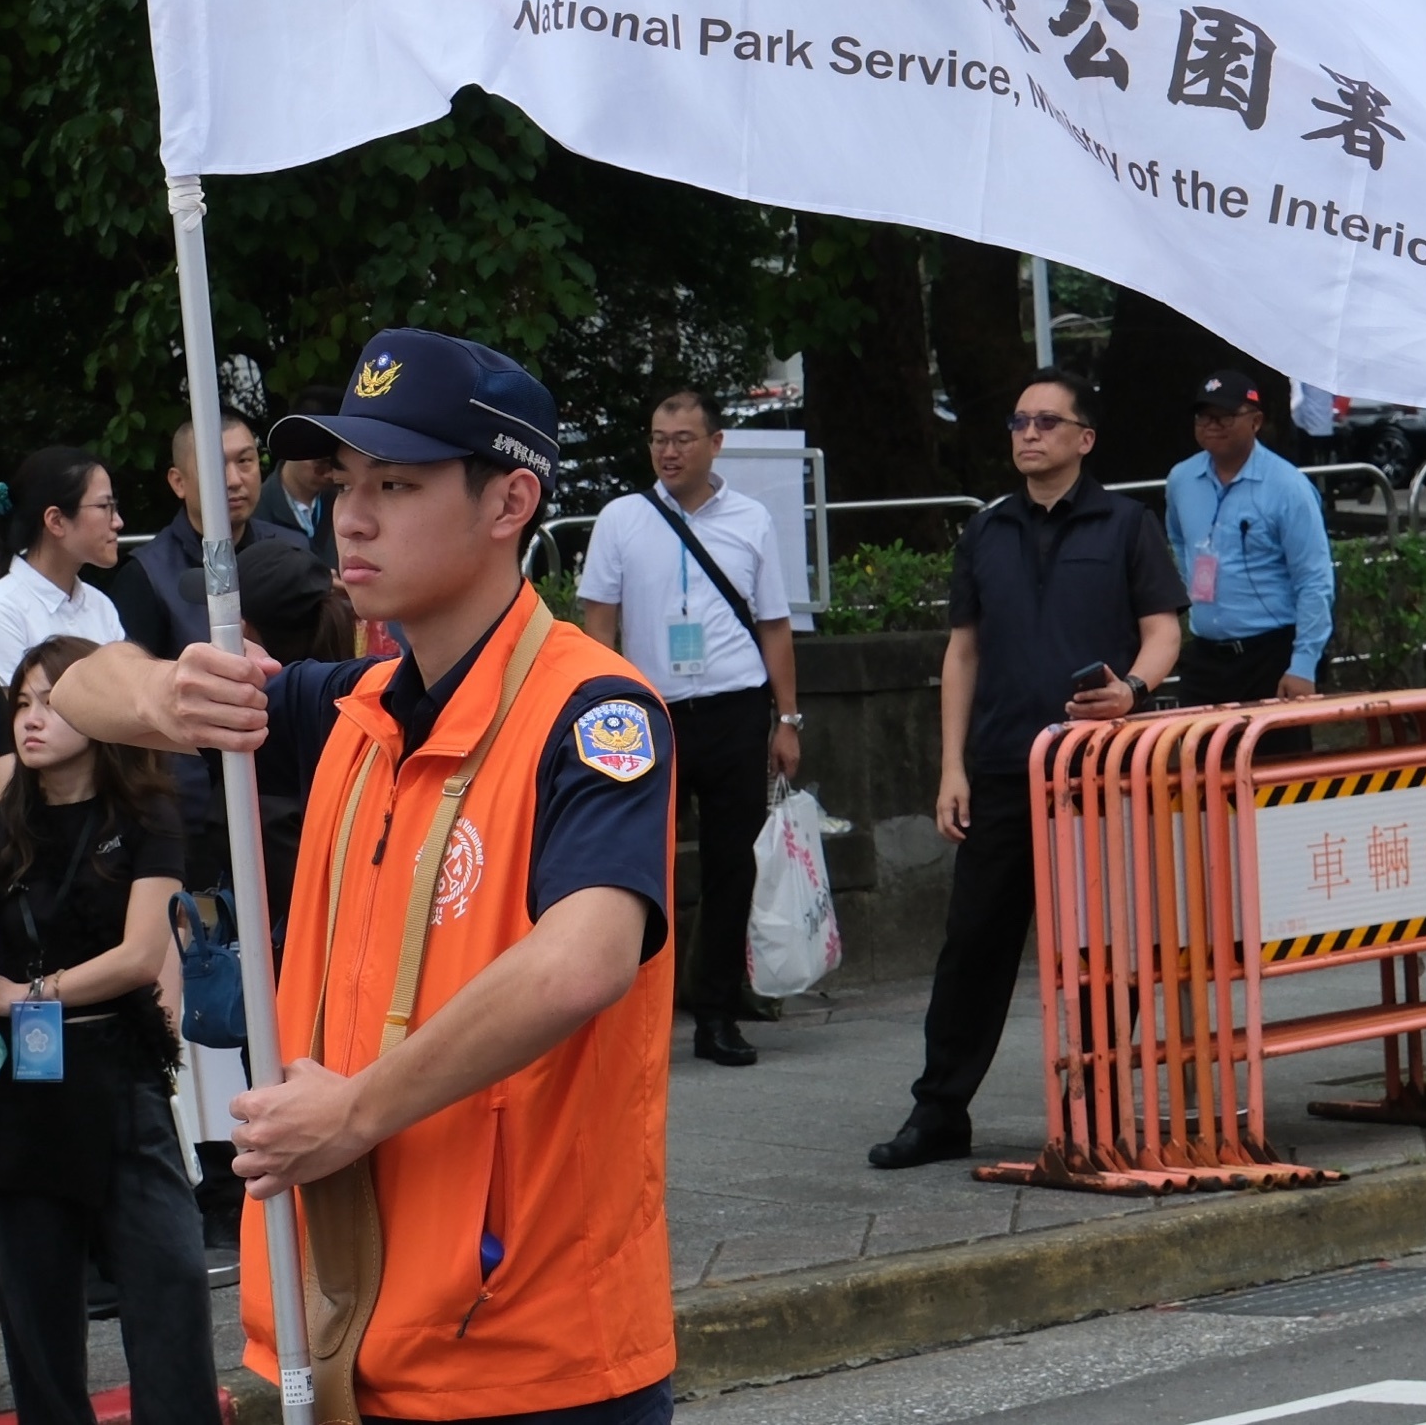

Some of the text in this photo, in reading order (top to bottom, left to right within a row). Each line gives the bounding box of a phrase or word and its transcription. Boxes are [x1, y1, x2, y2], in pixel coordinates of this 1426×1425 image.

[699, 17, 814, 70] Park
[828, 35, 1021, 108] Service,
[1026, 72, 1120, 183] Mistry
[1127, 160, 1160, 198] of
[1172, 169, 1249, 219] the
[463, 817, 484, 866] Volunteer
[431, 895, 469, 926] 災士
